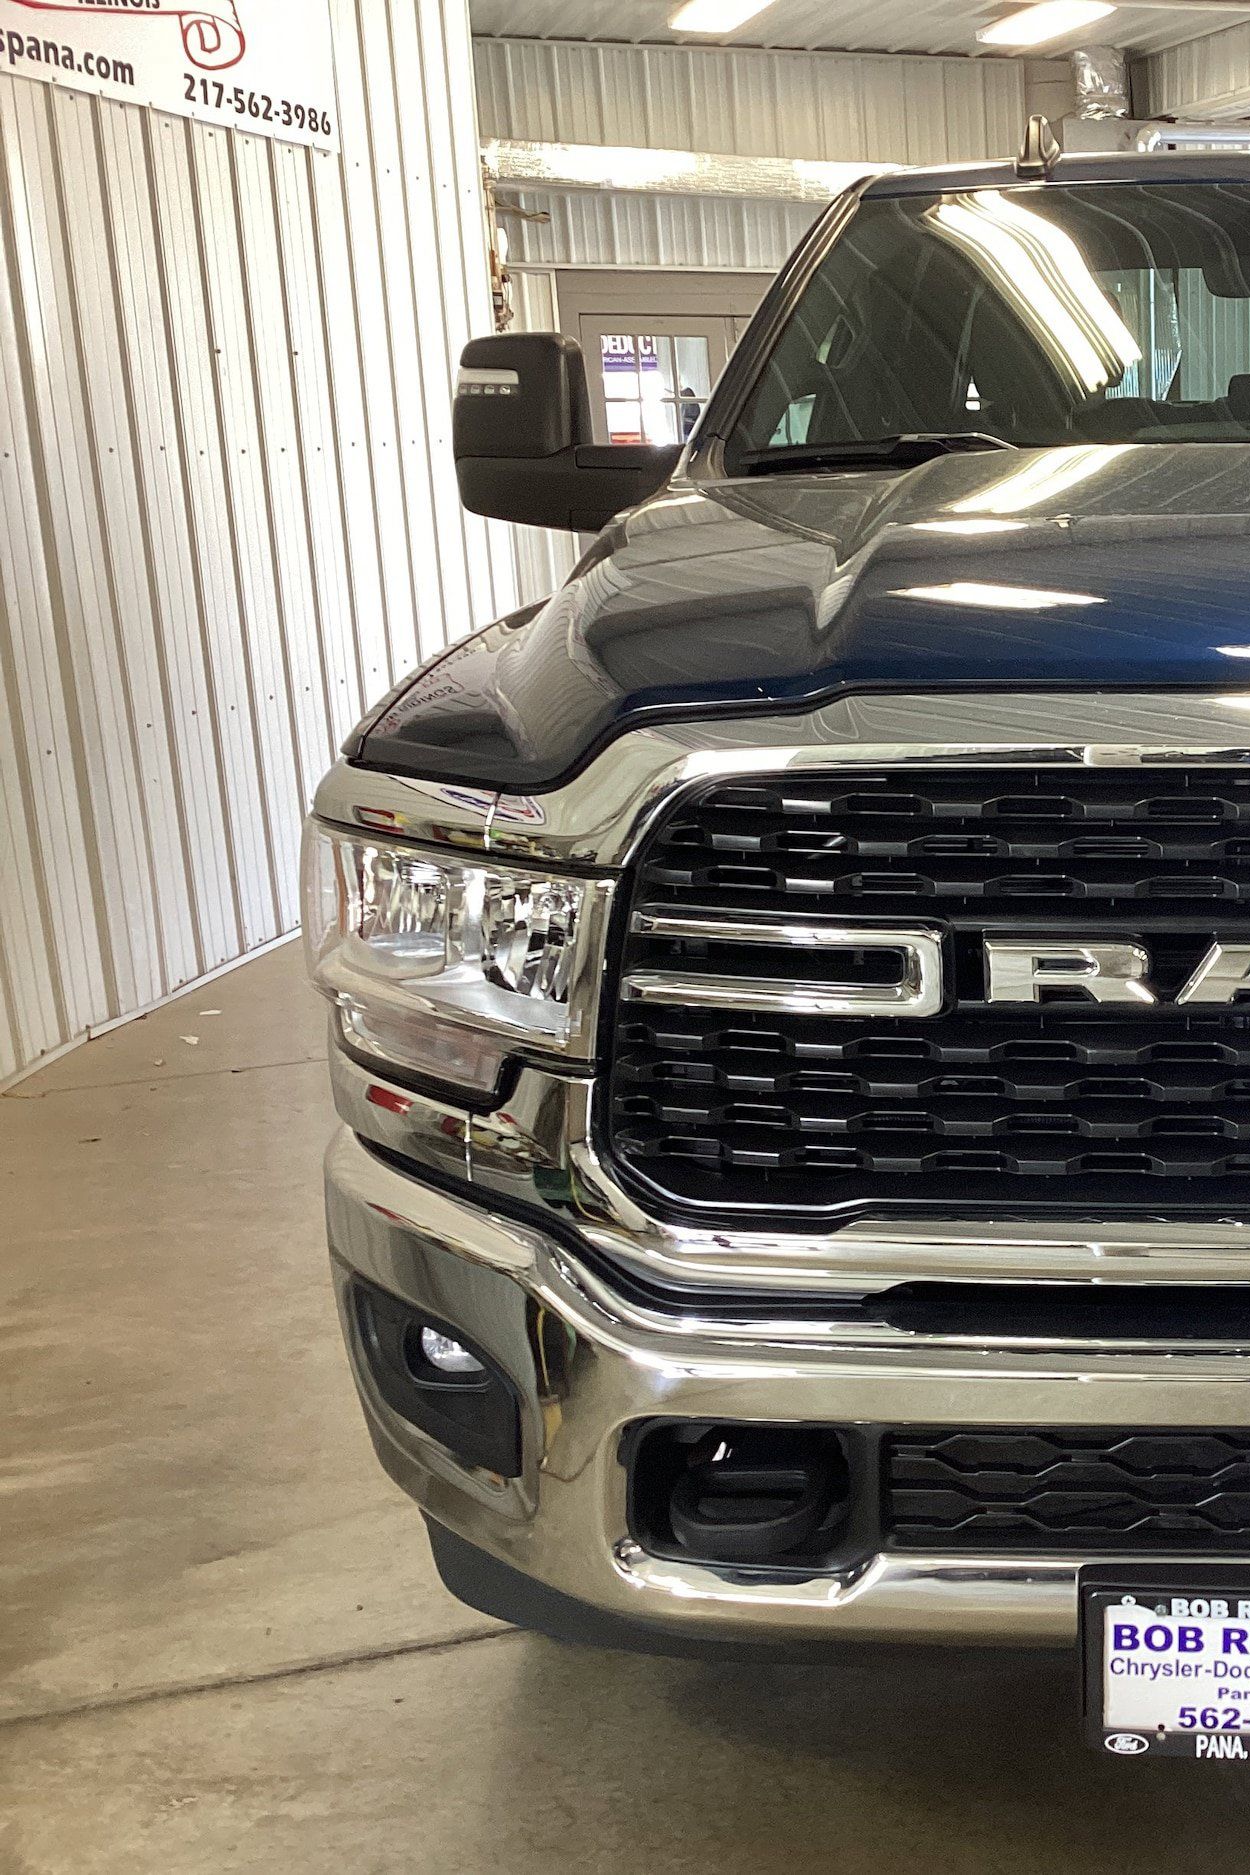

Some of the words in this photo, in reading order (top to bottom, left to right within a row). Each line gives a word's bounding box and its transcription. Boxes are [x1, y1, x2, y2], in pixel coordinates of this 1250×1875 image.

[183, 73, 331, 136] 217-562-3986
[1171, 1598, 1229, 1618] BOB
[1113, 1624, 1204, 1653] BOB
[1196, 1734, 1248, 1759] PANA,
